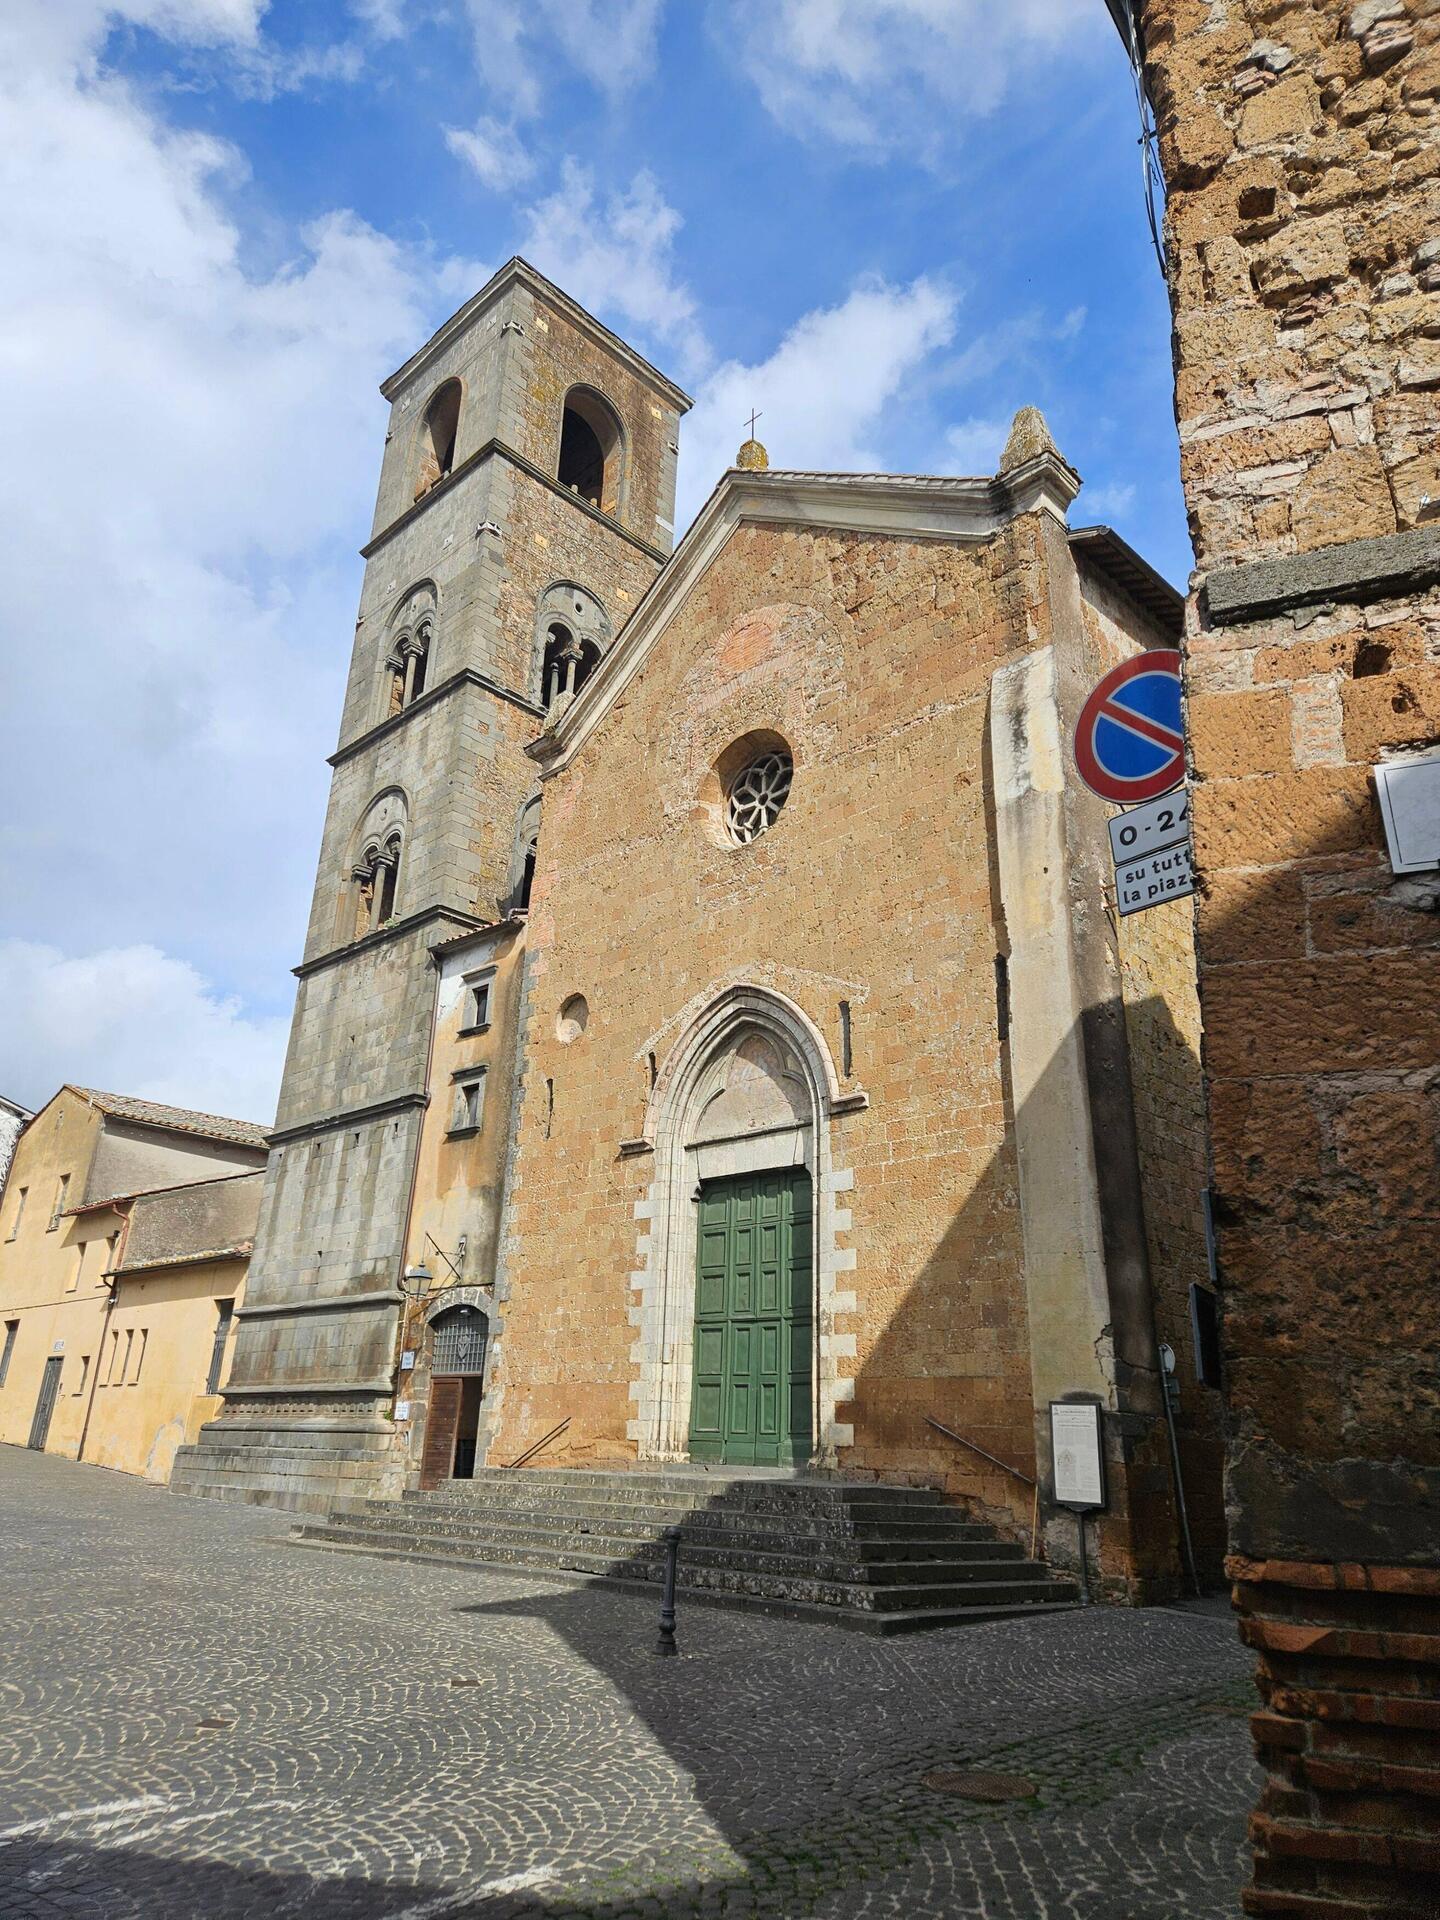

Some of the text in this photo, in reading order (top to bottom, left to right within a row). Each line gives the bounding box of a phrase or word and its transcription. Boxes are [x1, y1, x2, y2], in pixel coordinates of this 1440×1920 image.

[1125, 849, 1190, 883] su tutt
[1123, 873, 1192, 904] la piaz
